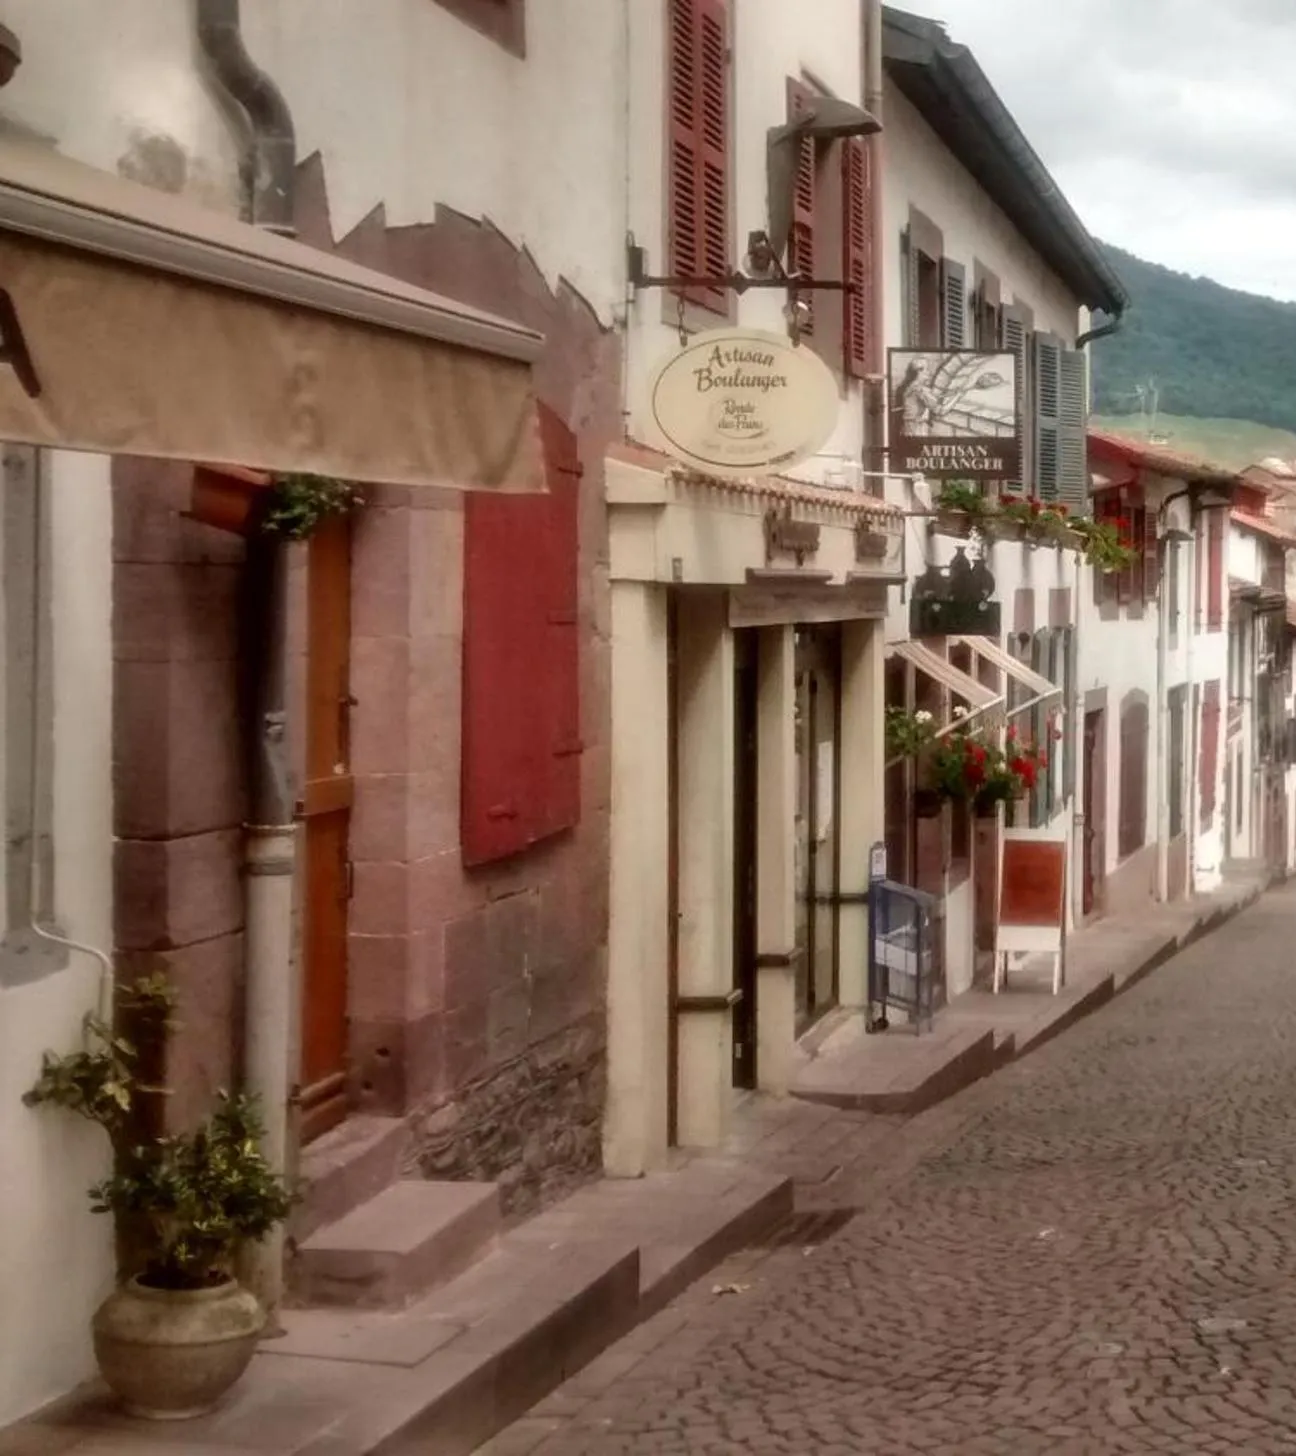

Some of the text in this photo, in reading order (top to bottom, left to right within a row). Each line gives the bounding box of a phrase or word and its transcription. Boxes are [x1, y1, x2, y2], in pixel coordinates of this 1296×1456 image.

[708, 345, 774, 368] Artisan
[692, 367, 788, 393] Boulanger
[921, 445, 988, 457] ARTISAN
[905, 457, 1003, 470] BOULANGER
